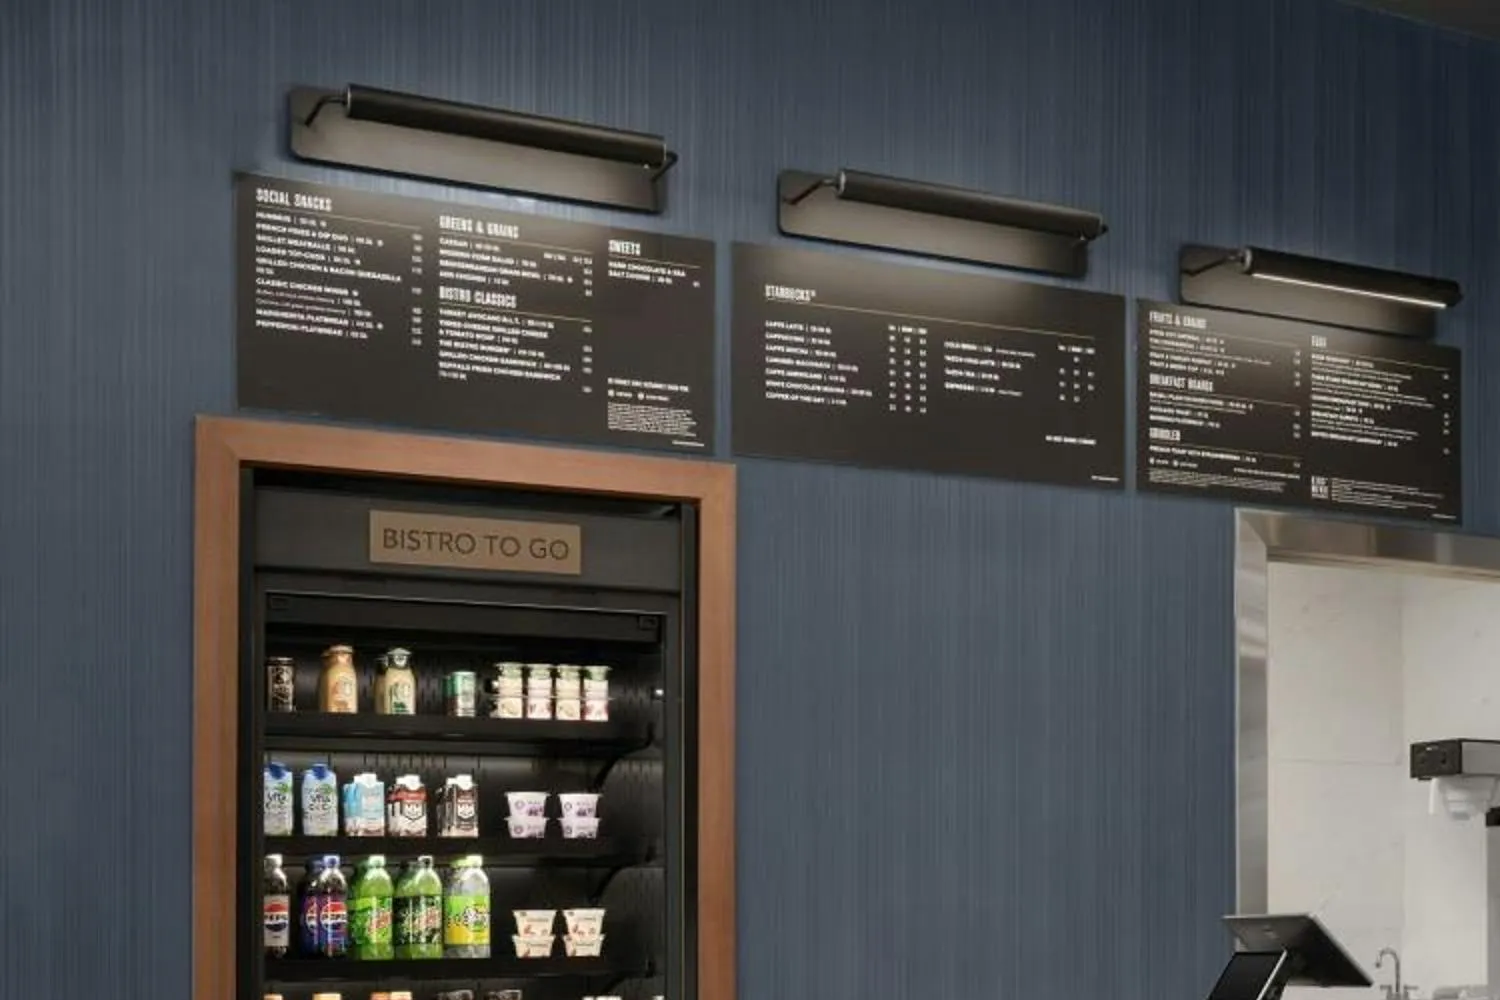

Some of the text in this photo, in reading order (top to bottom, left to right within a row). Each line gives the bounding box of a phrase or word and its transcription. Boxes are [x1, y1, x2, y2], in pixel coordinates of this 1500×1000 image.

[256, 188, 332, 212] SOCIAL SNACKS
[382, 527, 569, 560] BISTRO TO GO
